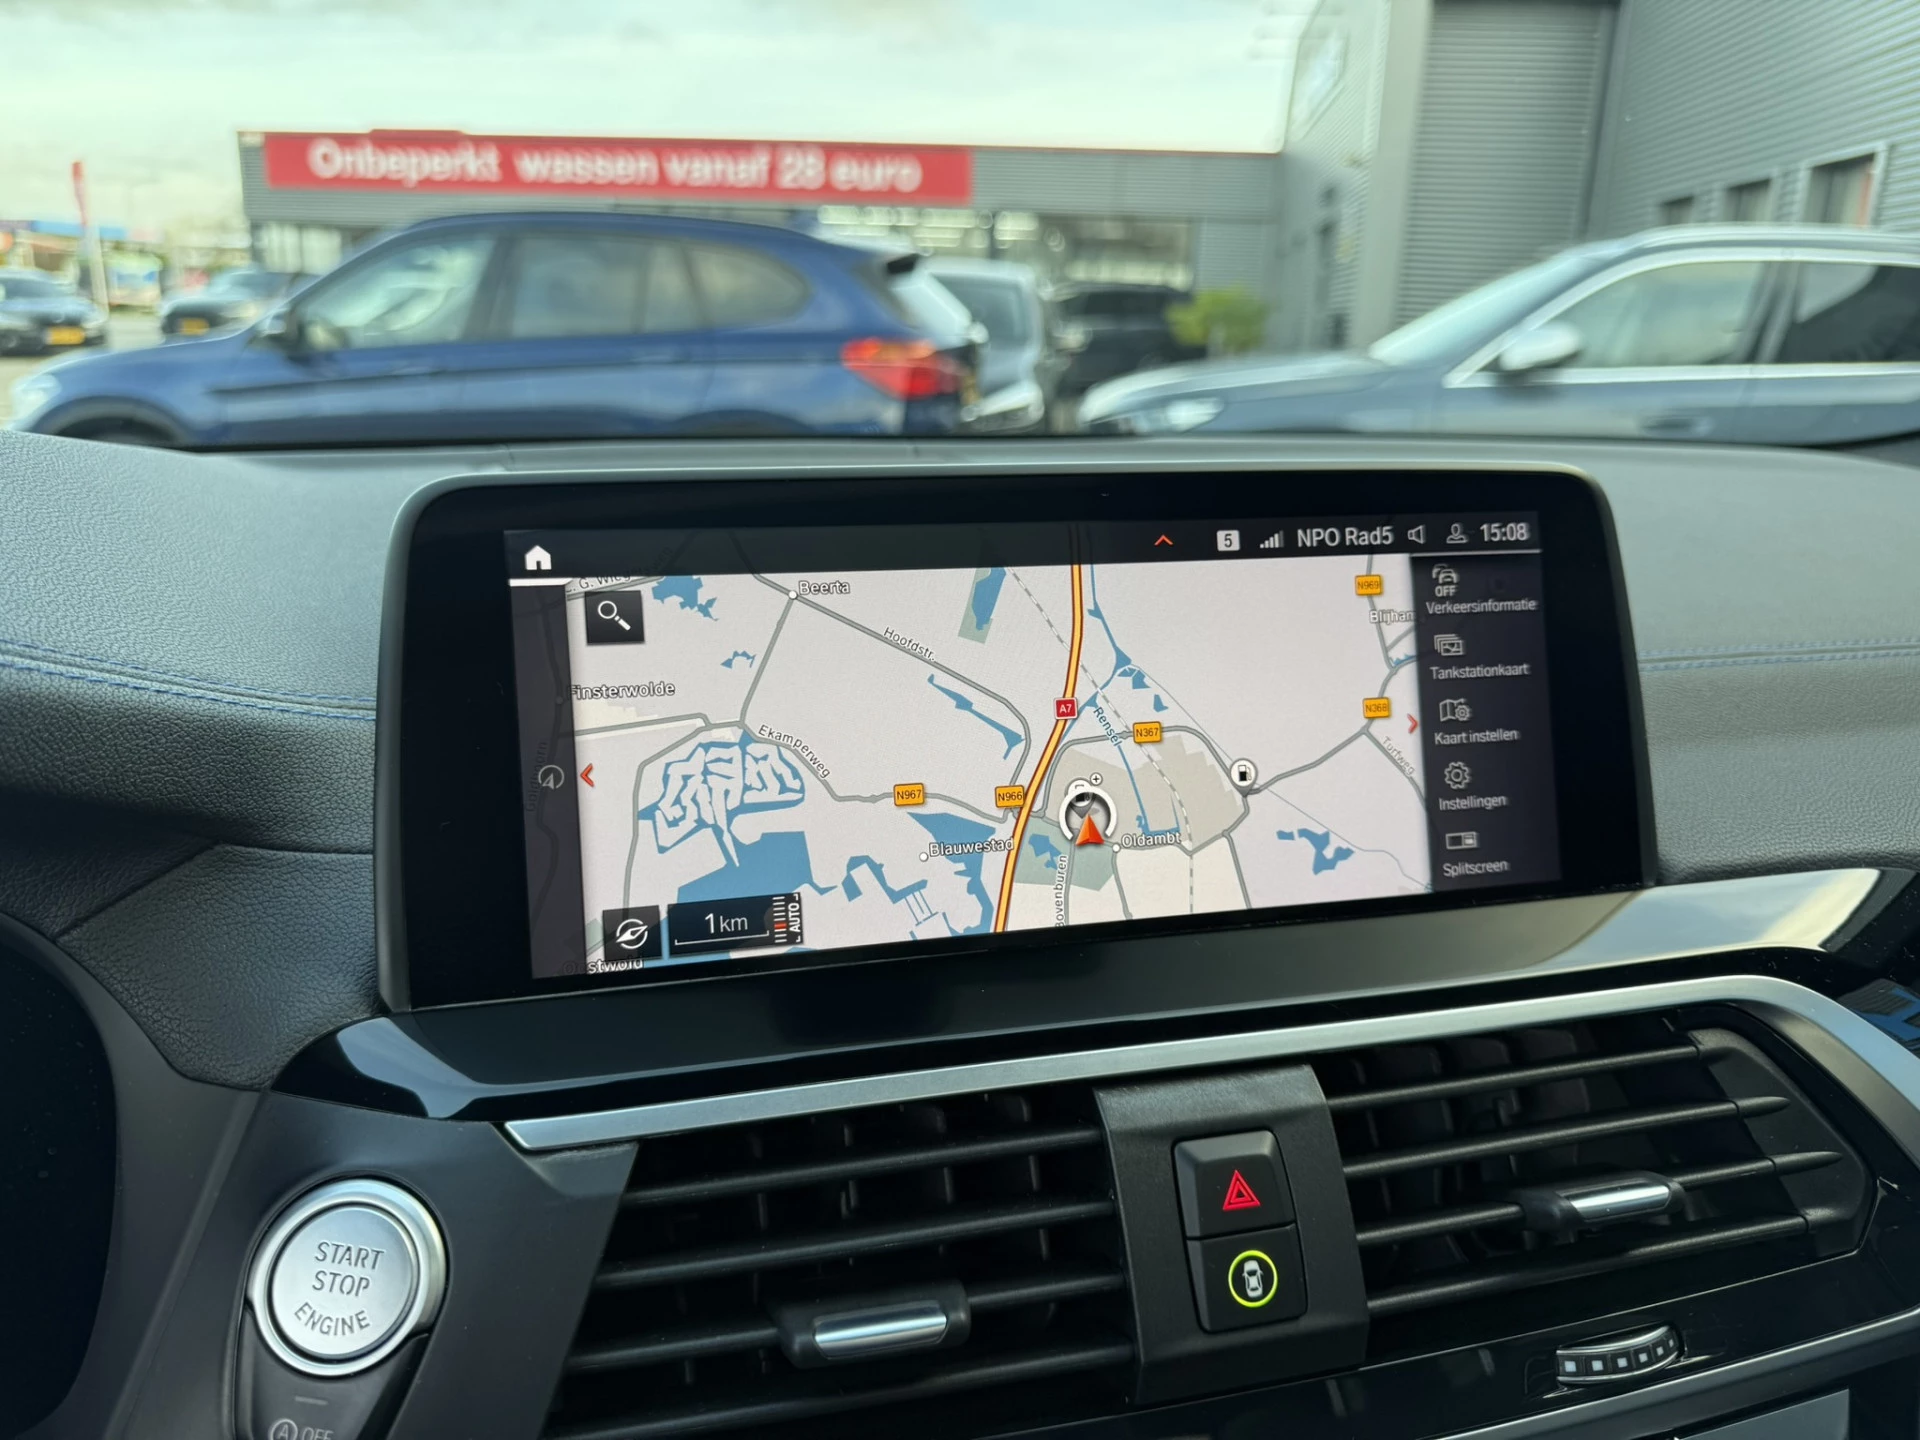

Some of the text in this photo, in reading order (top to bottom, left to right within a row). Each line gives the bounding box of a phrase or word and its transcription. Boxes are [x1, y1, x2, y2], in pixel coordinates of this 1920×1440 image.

[307, 137, 503, 188] Onbeperkt
[513, 147, 660, 185] wassen
[661, 143, 772, 188] vanaf
[829, 152, 923, 193] euro
[1297, 526, 1395, 548] NPO Rad5
[1480, 523, 1530, 542] 15:08
[798, 580, 850, 596] Beerta
[1356, 579, 1380, 592] N969
[1435, 585, 1457, 597] OFF
[1426, 598, 1538, 615] Verkeersinformatie
[883, 626, 935, 662] Hoofdstr.
[1430, 663, 1530, 680] Tankstationkaart
[1059, 703, 1073, 714] A7
[1093, 706, 1123, 748] Rensel
[1135, 726, 1160, 738] N367
[1434, 728, 1521, 745] Kaart instellen
[758, 723, 831, 779] Ekamperweg
[1381, 736, 1416, 775] Turfweg
[896, 788, 922, 800] N967
[997, 790, 1023, 802] N966
[1438, 795, 1508, 811] Instellingen
[929, 837, 1015, 858] Blauwestad
[1121, 831, 1181, 849] Oldambt
[1442, 860, 1511, 877] Splitscreen
[705, 913, 748, 934] 1 km
[789, 902, 801, 934] AUTO
[314, 1241, 384, 1271] START
[312, 1270, 370, 1298] STOP
[294, 1302, 370, 1336] ENGINE
